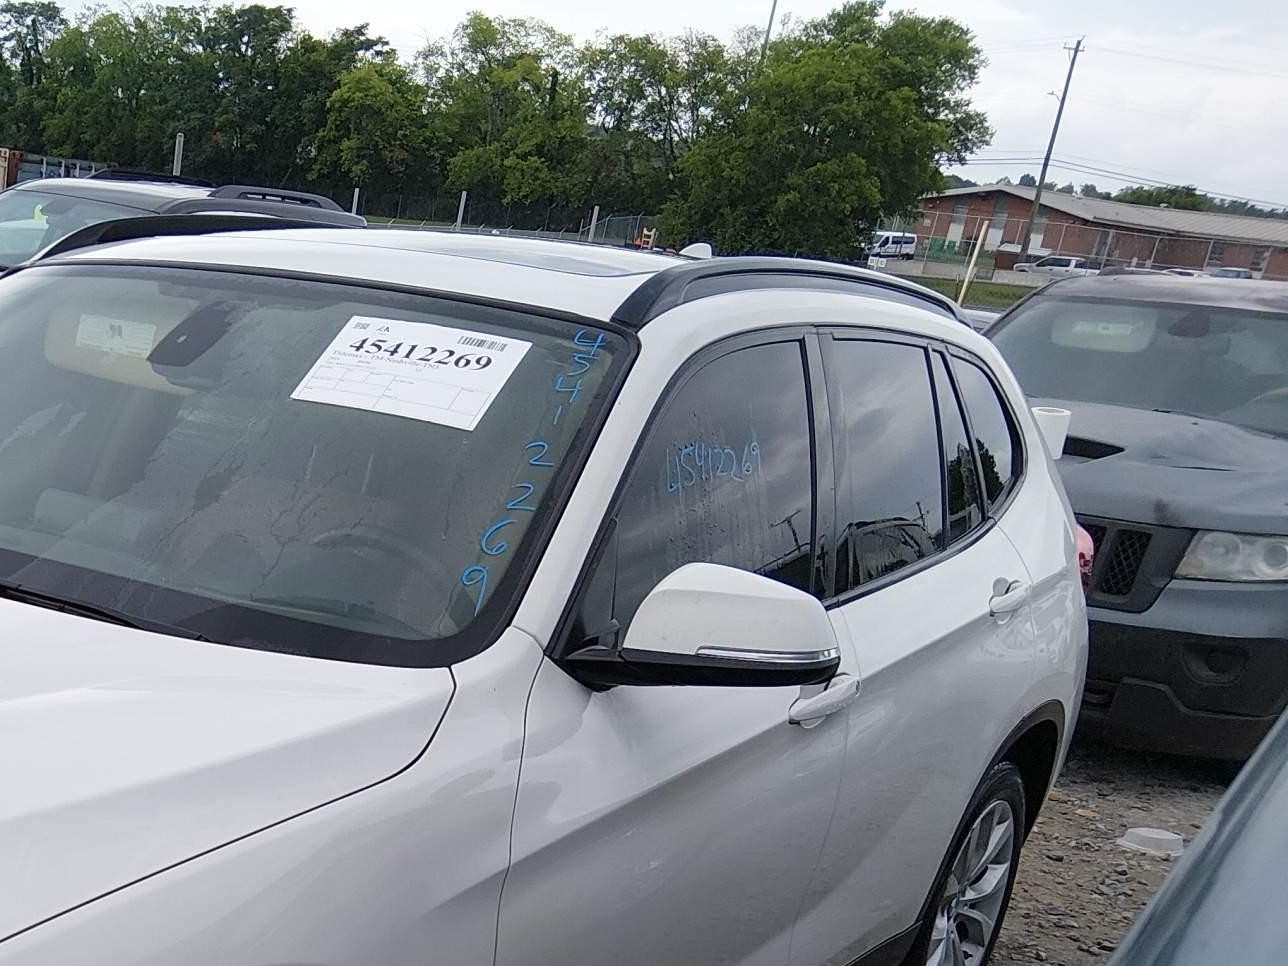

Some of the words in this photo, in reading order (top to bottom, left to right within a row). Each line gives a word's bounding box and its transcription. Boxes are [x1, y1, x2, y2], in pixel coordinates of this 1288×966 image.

[348, 336, 493, 371] 45412269
[461, 328, 606, 617] 45412269
[666, 440, 761, 505] 45412269
